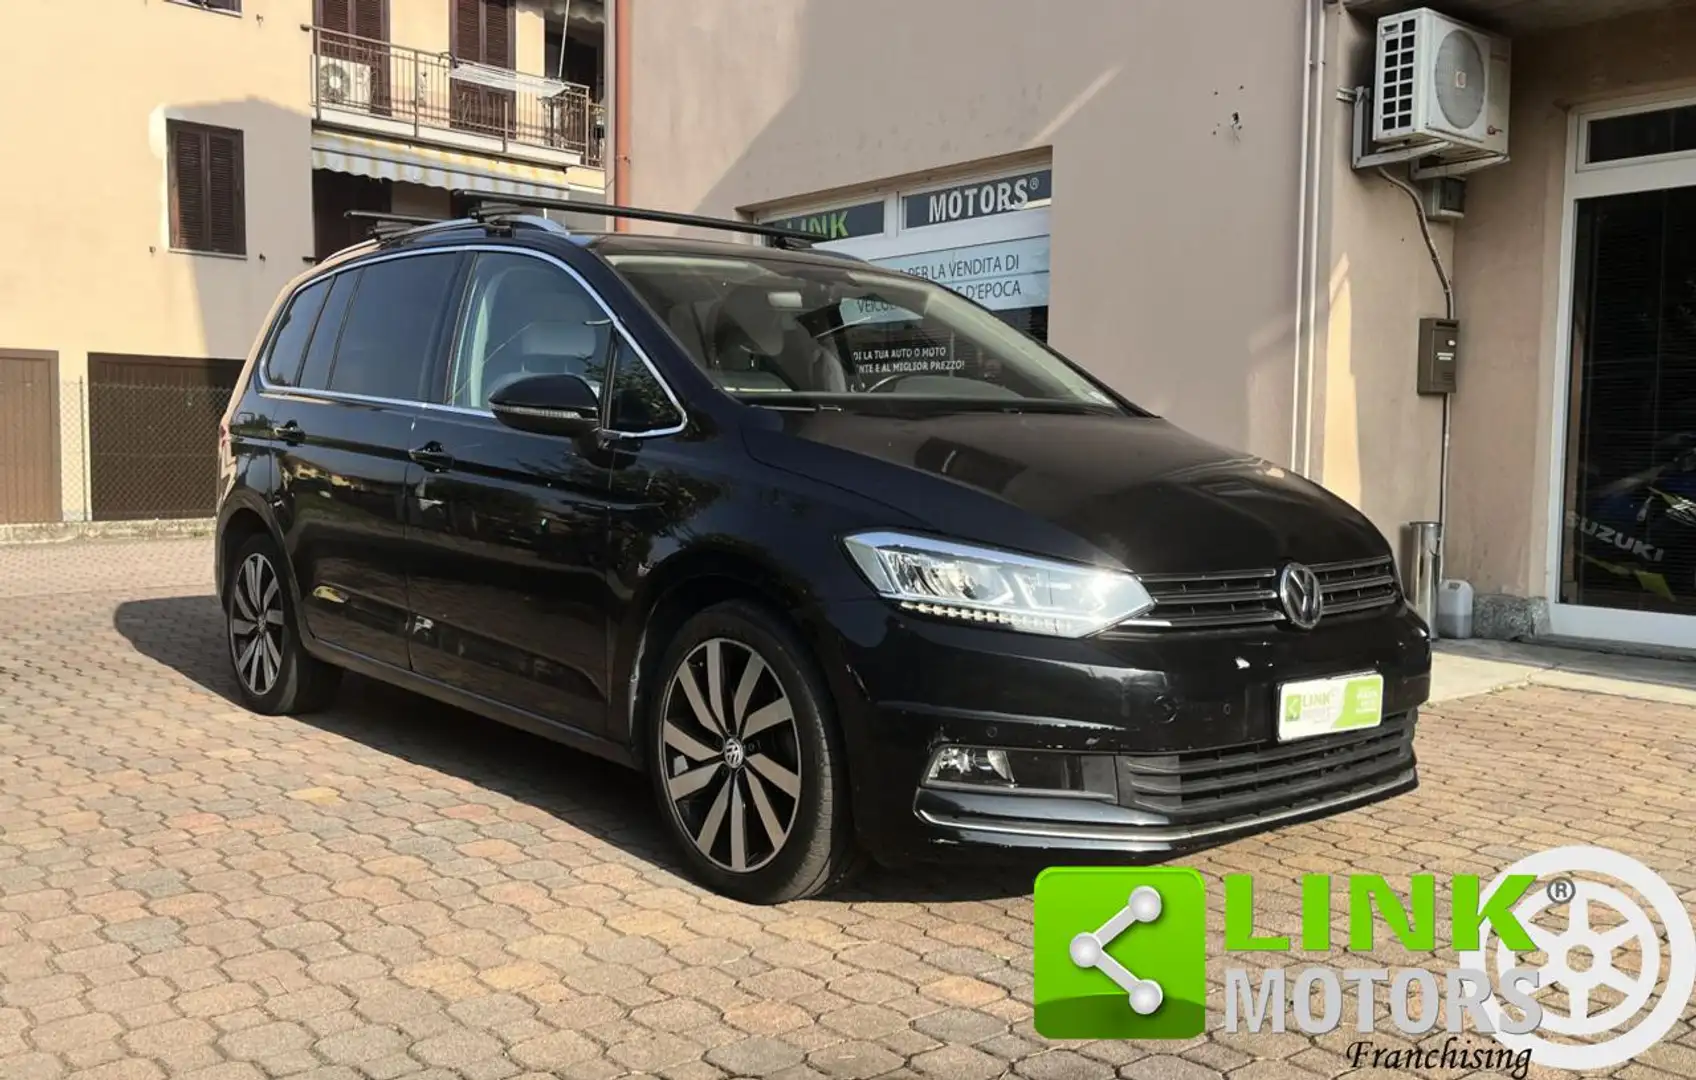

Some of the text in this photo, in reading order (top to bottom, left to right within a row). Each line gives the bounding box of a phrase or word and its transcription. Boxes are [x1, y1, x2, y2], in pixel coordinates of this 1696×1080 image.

[932, 264, 946, 279] LA
[949, 256, 1002, 277] VENDITA
[1006, 254, 1019, 270] DI
[966, 280, 1022, 300] D'EPOCA
[863, 350, 873, 361] LA
[874, 349, 889, 360] TUA
[891, 348, 913, 358] AUTO
[914, 348, 921, 358] O
[922, 347, 947, 358] MOTO
[881, 362, 892, 373] AL
[893, 361, 929, 373] MIGLIOR
[930, 359, 965, 371] PREZZO!
